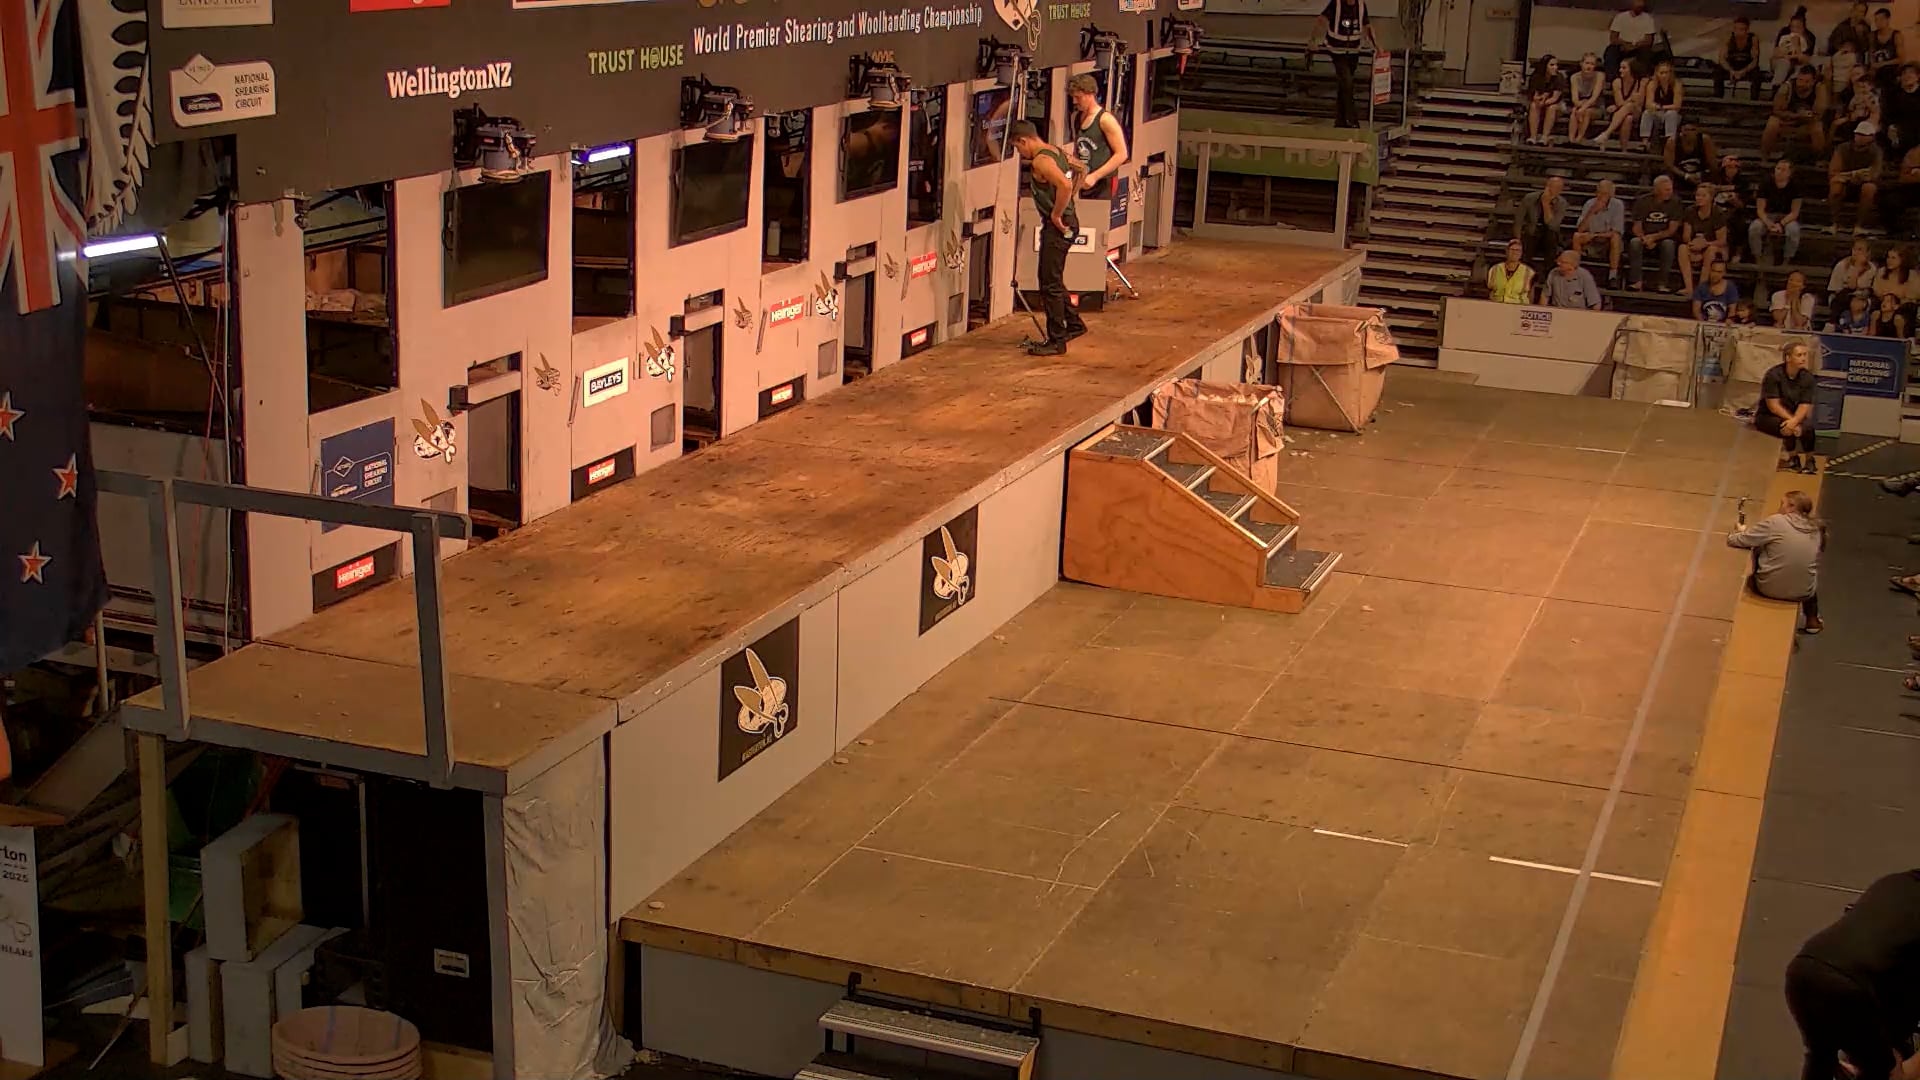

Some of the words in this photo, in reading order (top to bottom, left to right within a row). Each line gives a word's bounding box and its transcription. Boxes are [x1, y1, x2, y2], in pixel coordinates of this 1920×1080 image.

[1048, 4, 1069, 20] TRUST
[693, 26, 730, 55] World
[736, 22, 781, 50] Premier
[785, 17, 833, 44] Shearing
[837, 14, 855, 37] and
[858, 8, 921, 36] Woolhandling
[923, 3, 983, 31] Championship
[588, 49, 635, 74] TRUST
[640, 45, 684, 70] HOUSE
[234, 72, 270, 84] NATIONAL
[387, 62, 512, 99] WellingtonNZ
[234, 84, 270, 97] SHEARING
[235, 97, 263, 110] CIRCUIT
[1849, 360, 1890, 370] NATIONAL
[1848, 367, 1890, 377] SHEARING
[590, 371, 622, 393] BAYLEYS
[1848, 375, 1879, 383] CIRCUIT
[0, 845, 28, 864] ton
[3, 870, 29, 883] 2025
